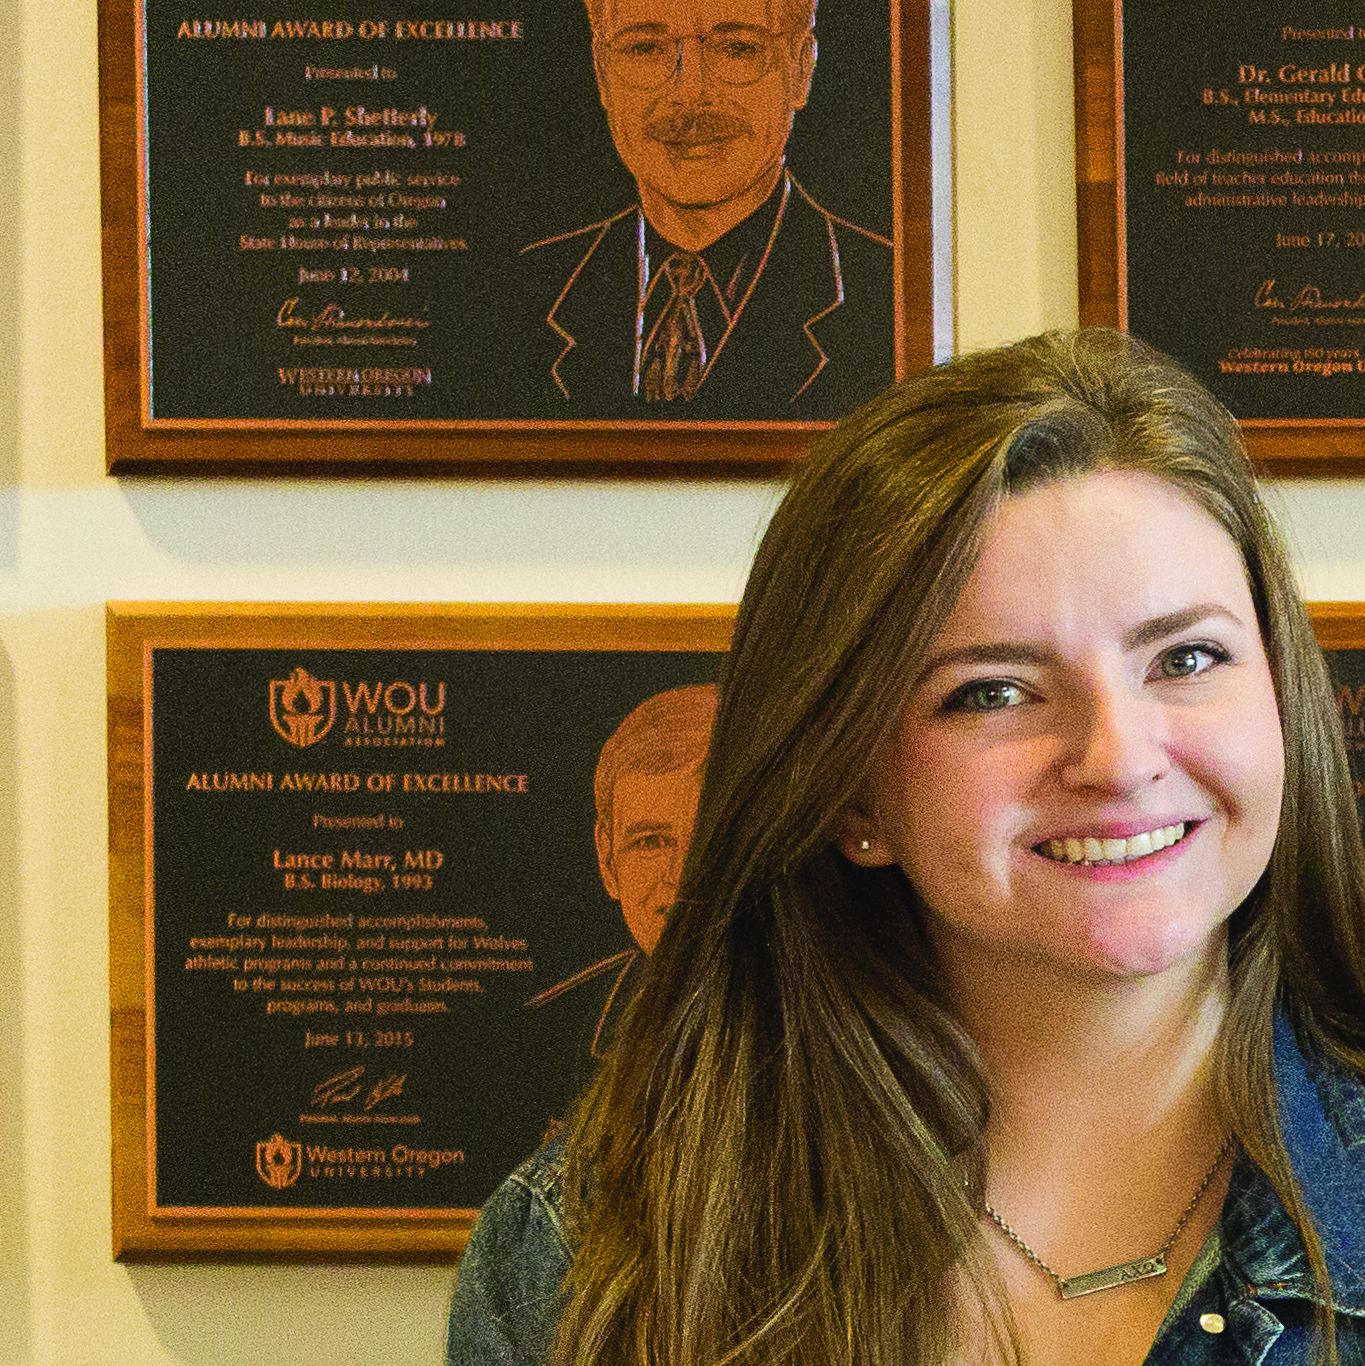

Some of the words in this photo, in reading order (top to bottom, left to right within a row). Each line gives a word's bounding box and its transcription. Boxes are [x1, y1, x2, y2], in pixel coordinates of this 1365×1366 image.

[177, 21, 266, 39] ALUMNI
[271, 21, 353, 39] AWARD
[358, 21, 388, 39] OF
[394, 21, 523, 39] EXCELLENCE
[1282, 25, 1354, 40] Presented
[1238, 64, 1271, 84] Dr.
[1278, 62, 1350, 83] Gerald
[1244, 88, 1335, 107] Elementary
[264, 106, 313, 126] Lane
[1276, 233, 1310, 248] June
[1316, 233, 1340, 248] 17,
[1219, 361, 1288, 376] Western
[1293, 360, 1353, 377] Oregon
[343, 682, 446, 715] WOU
[343, 717, 445, 734] ALUMNI
[185, 772, 273, 792] ALUMNI
[279, 772, 360, 792] AWARD
[366, 773, 395, 792] OF
[402, 773, 528, 793] EXCELLENCE
[273, 850, 333, 870] Lance
[340, 851, 396, 872] Marr,
[404, 850, 444, 870] MD
[283, 874, 315, 889] B.S.
[321, 874, 385, 894] Biology,
[305, 1031, 339, 1048] June
[307, 1146, 386, 1163] Western
[391, 1144, 464, 1167] Oregon
[309, 1166, 426, 1177] UNIVERSITY
